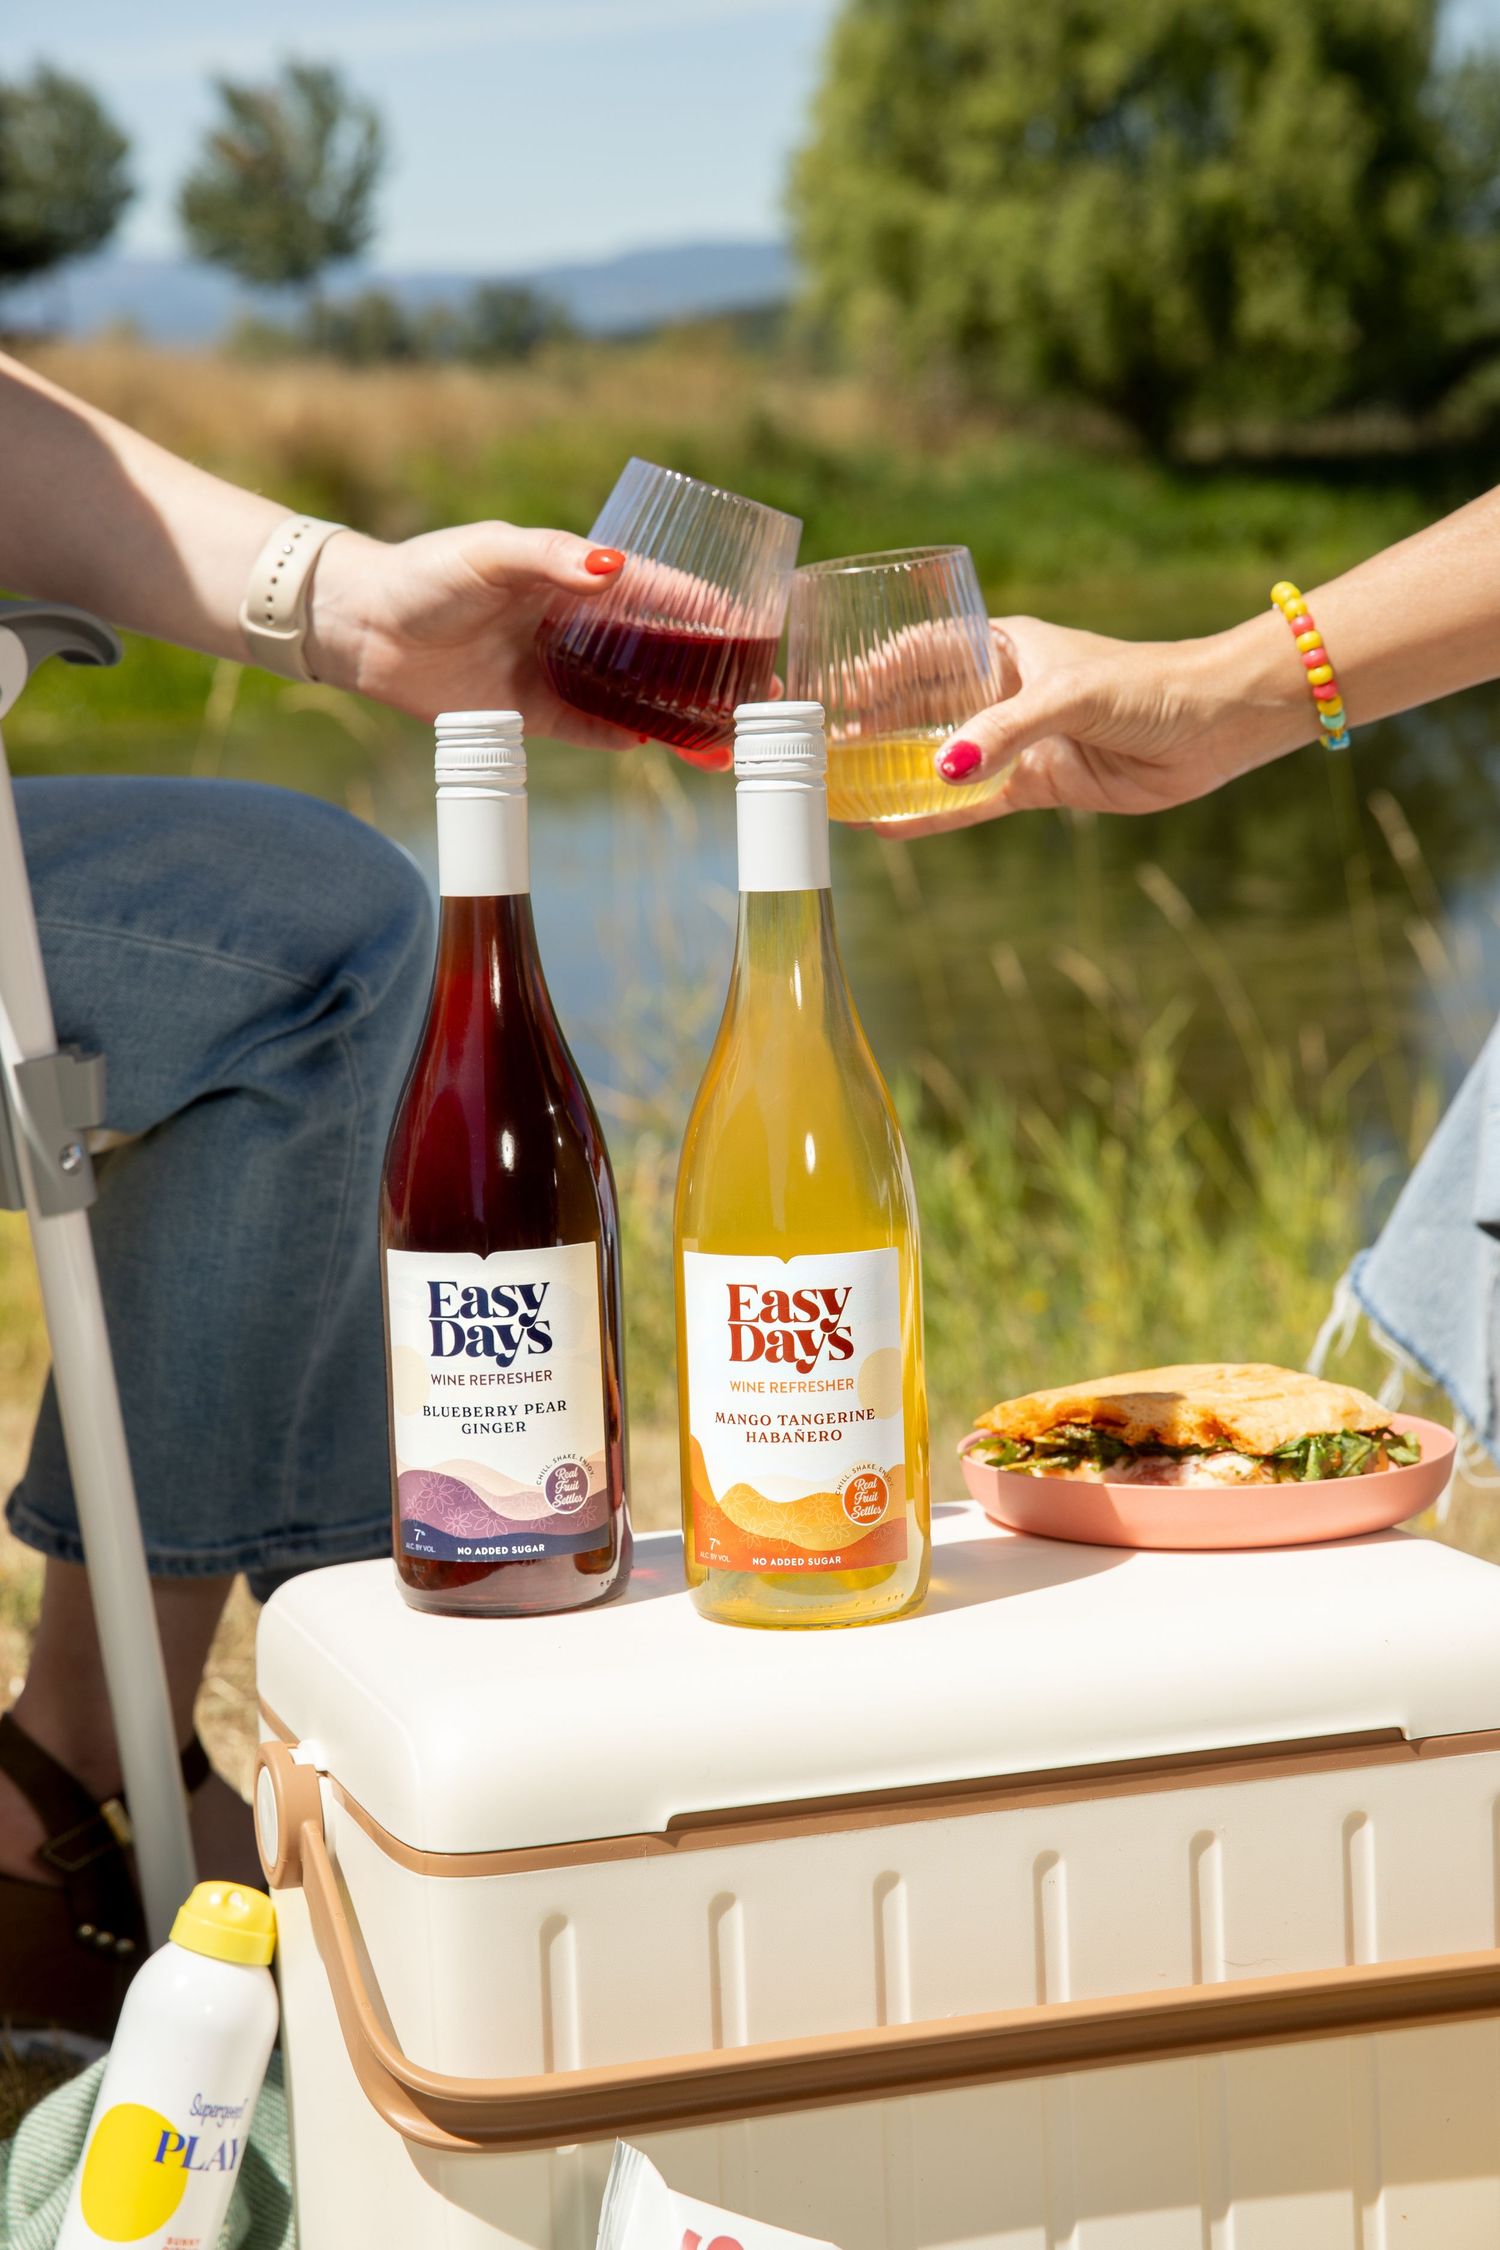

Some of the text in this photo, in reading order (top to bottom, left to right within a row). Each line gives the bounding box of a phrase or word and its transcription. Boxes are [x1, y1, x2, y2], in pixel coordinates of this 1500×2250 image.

[427, 1281, 550, 1328] Easy
[726, 1283, 853, 1333] Easy
[429, 1319, 553, 1368] Days
[728, 1323, 855, 1375] Days
[431, 1369, 553, 1386] WINE REFRESHER
[729, 1378, 855, 1394] WINE REFRESHER
[423, 1399, 568, 1418] BLUEBERRY PEAR
[715, 1408, 876, 1426] MANGO TANGERINE
[461, 1421, 526, 1435] GINGER
[746, 1428, 843, 1443] HABAÑERO
[555, 1467, 579, 1481] Real
[555, 1479, 579, 1494] Fruit
[854, 1477, 878, 1492] Real
[552, 1493, 583, 1508] Settles
[854, 1490, 878, 1505] Fruit
[851, 1504, 882, 1519] Settles
[457, 1544, 545, 1556] NO ADDED SUGAR
[752, 1555, 841, 1566] NO ADDED SUGAR
